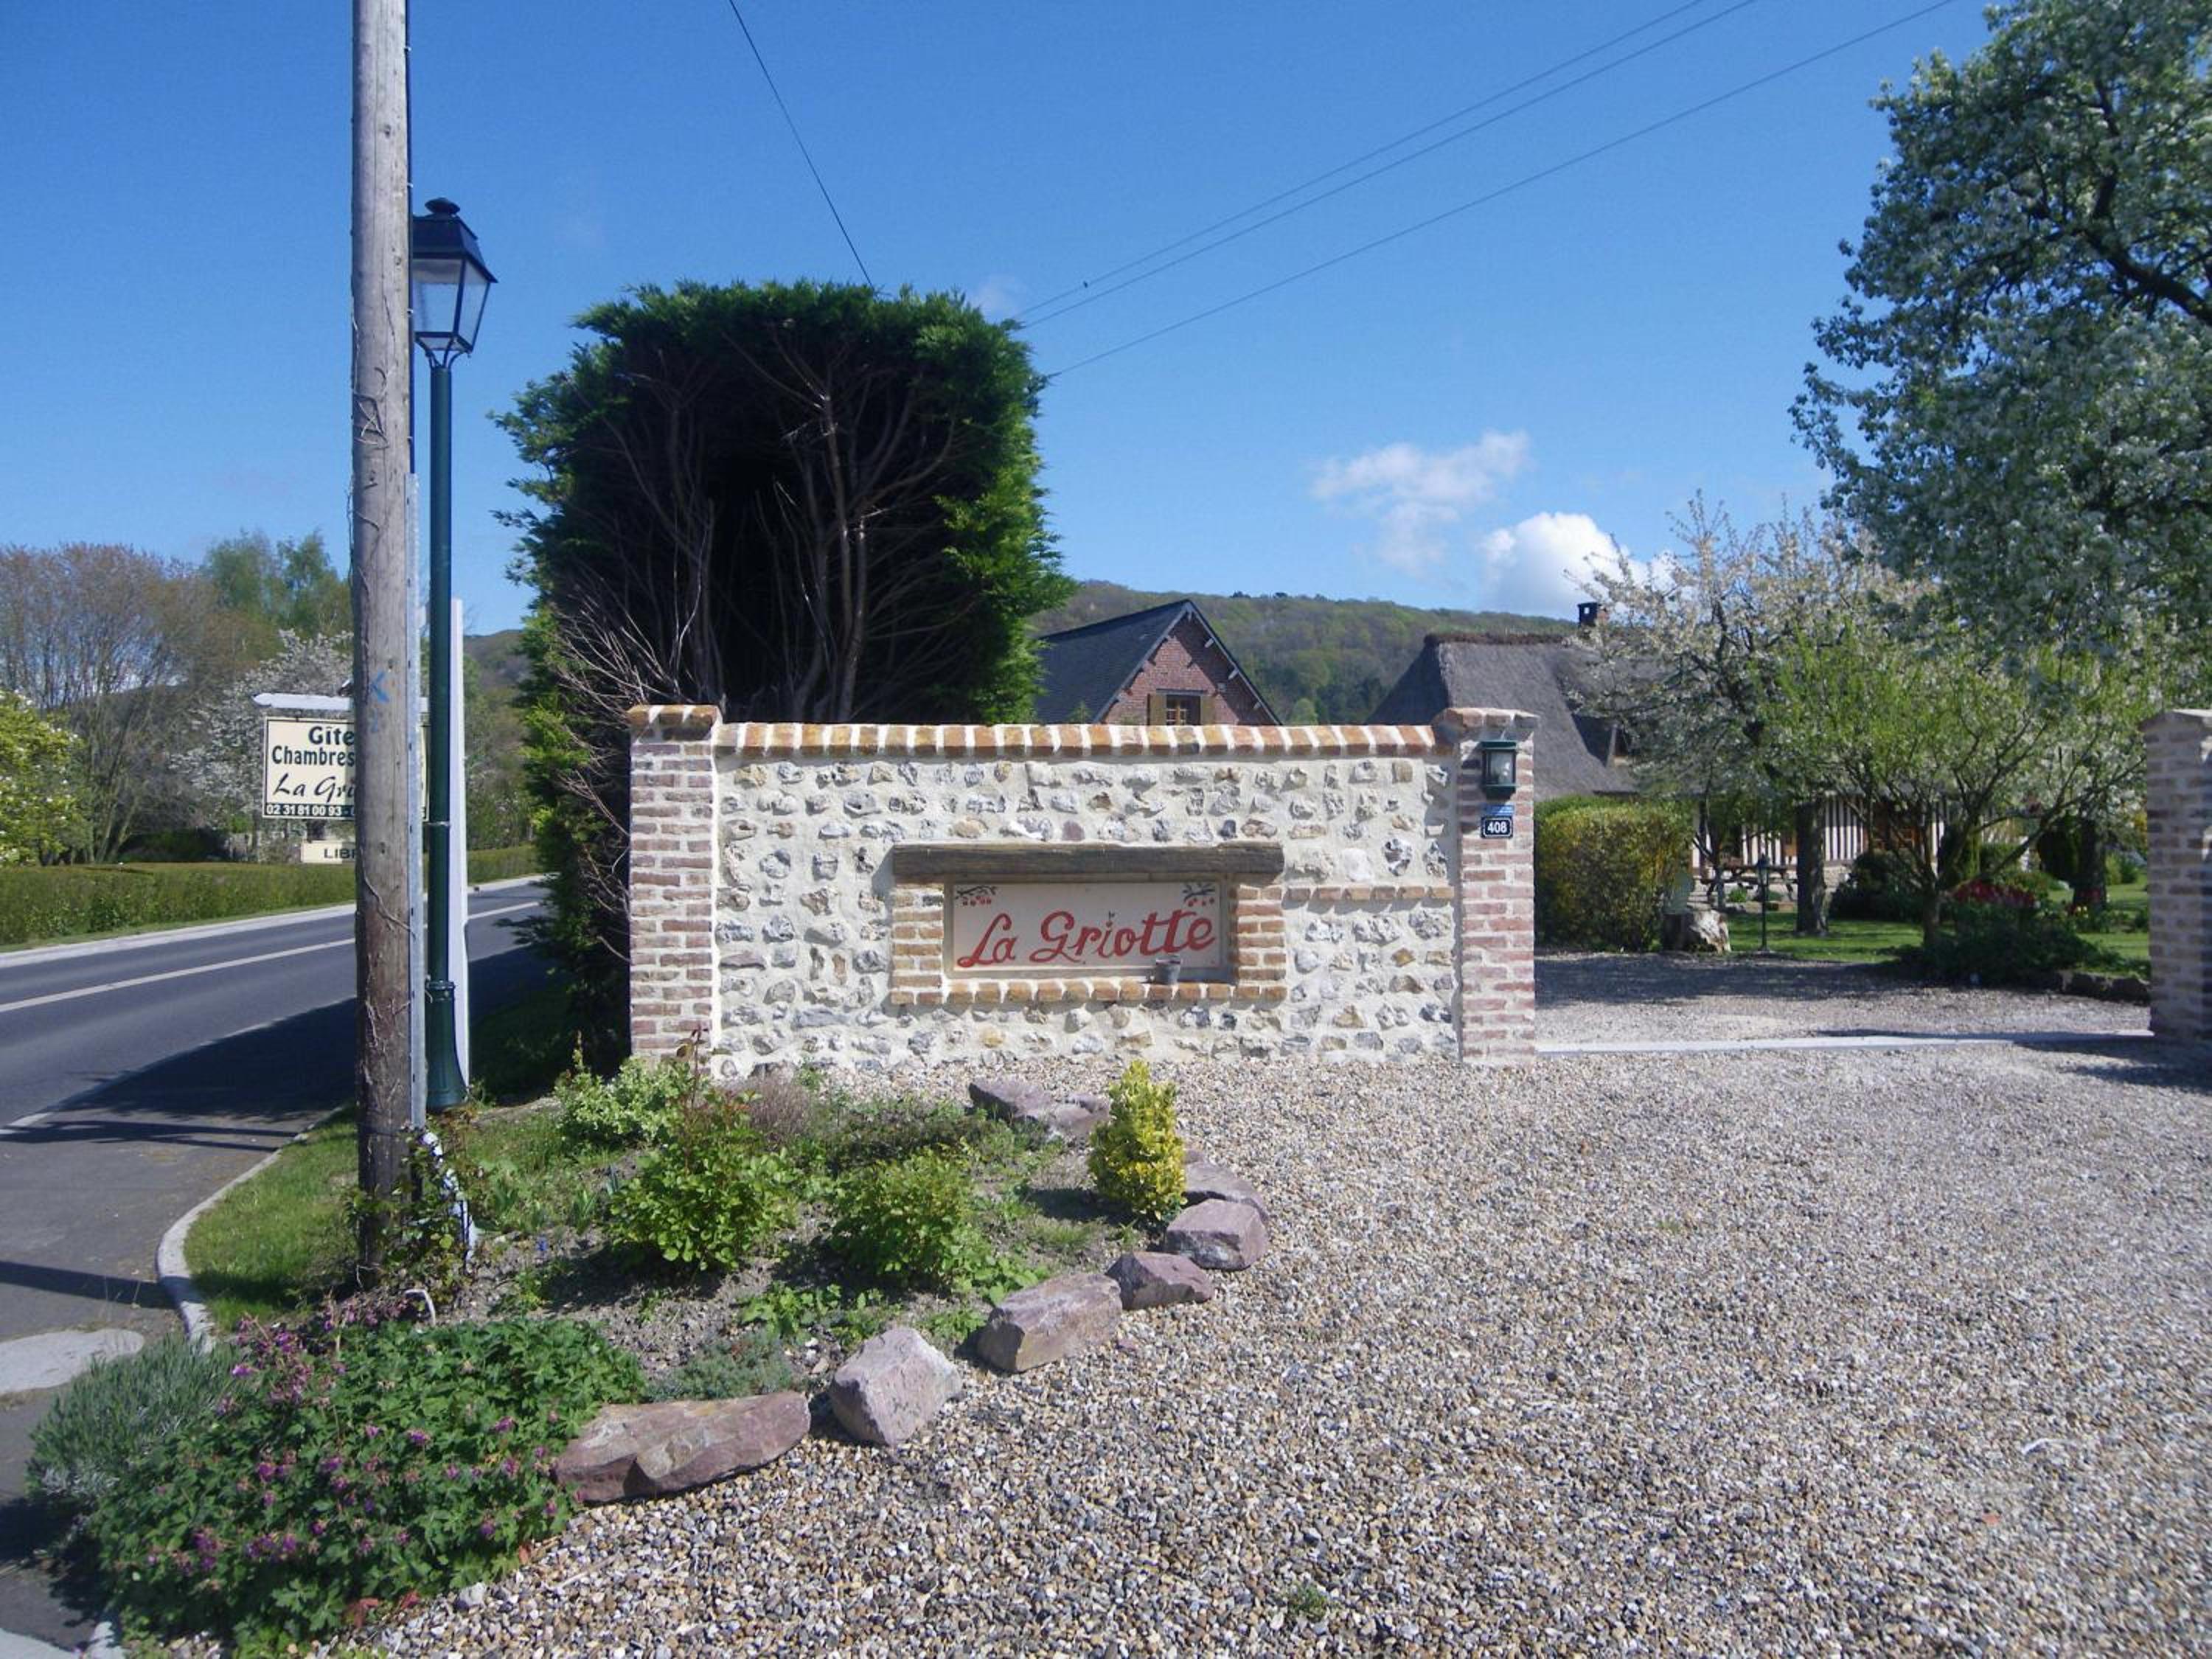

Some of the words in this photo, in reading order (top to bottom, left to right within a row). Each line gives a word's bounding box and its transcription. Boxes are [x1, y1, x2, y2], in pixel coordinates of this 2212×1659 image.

[272, 745, 355, 767] Chambres
[272, 773, 306, 797] La
[266, 804, 280, 814] 02
[282, 804, 296, 815] 31
[298, 804, 310, 815] 81
[312, 805, 326, 815] 00
[328, 805, 342, 815] 93
[1488, 821, 1508, 833] 408
[957, 913, 1019, 967] La
[1029, 908, 1216, 964] Griotte
